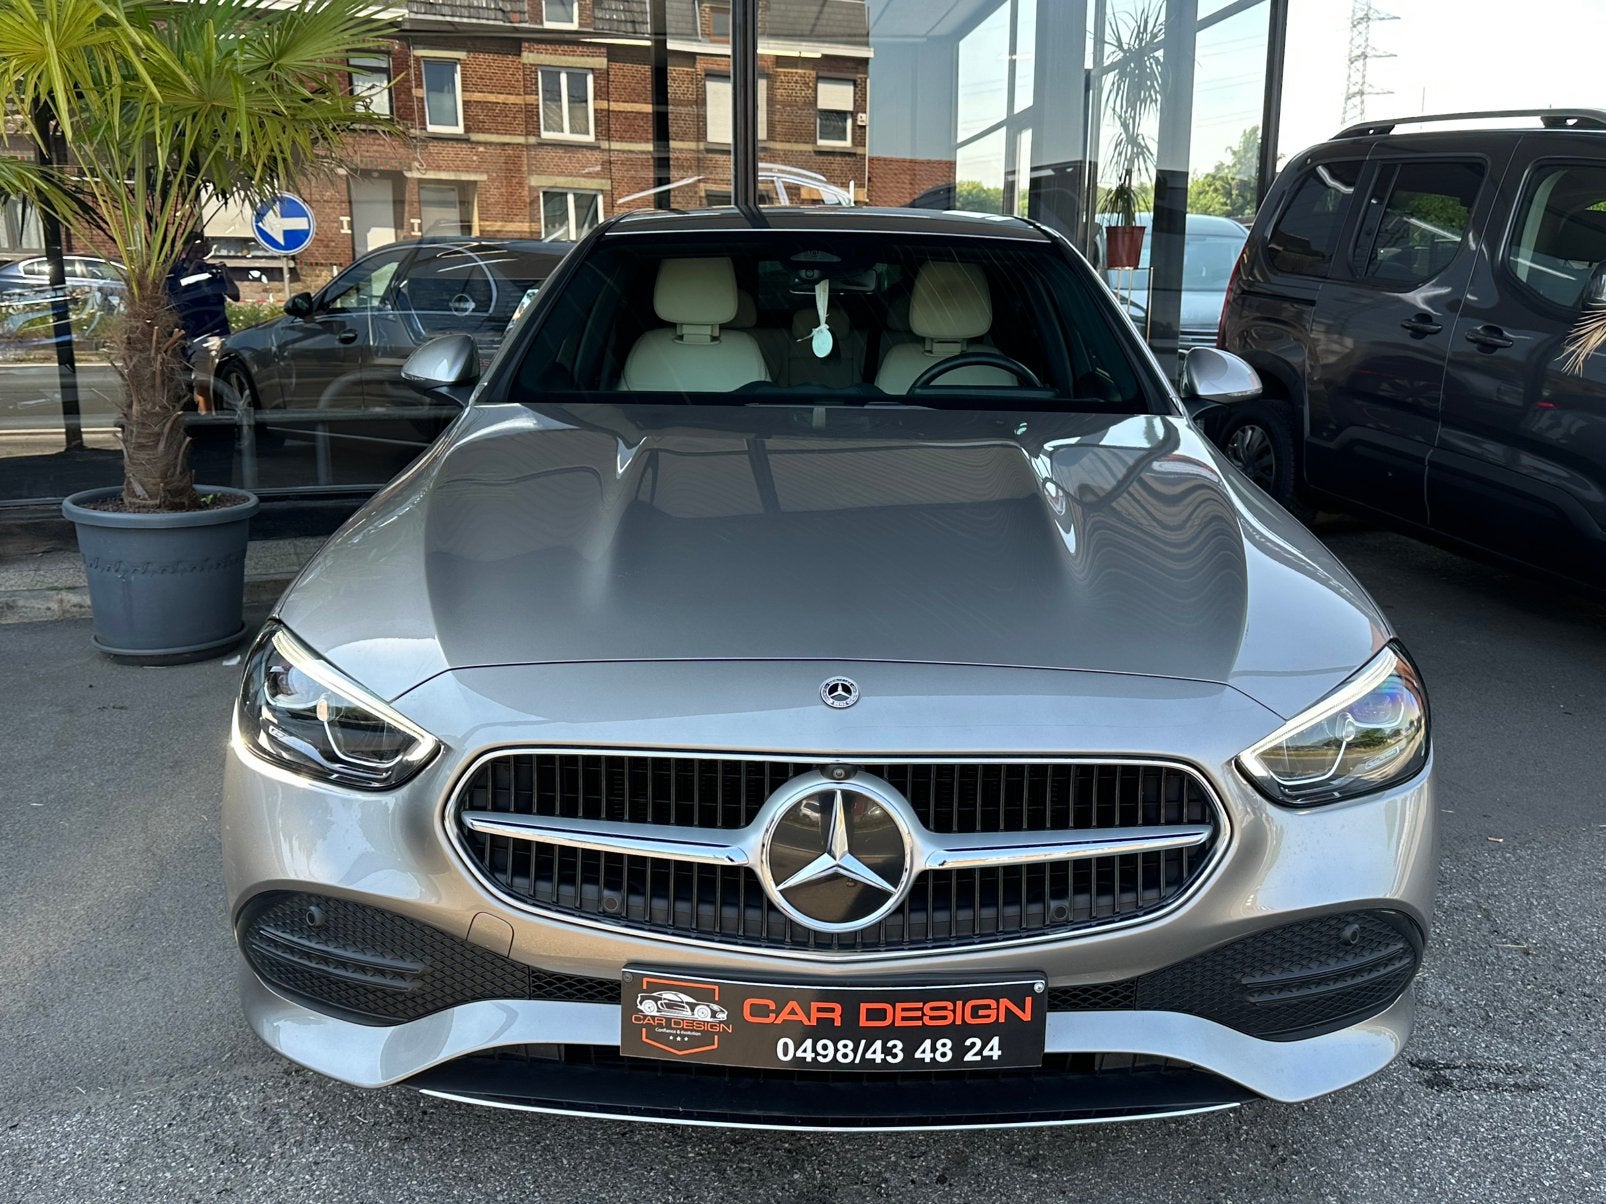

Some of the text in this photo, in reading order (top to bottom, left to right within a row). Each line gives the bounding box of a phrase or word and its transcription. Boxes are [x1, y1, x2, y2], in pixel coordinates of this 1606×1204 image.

[632, 1014, 733, 1033] CAR DESIGN
[743, 996, 1032, 1027] CAR DESIGN
[776, 1035, 1002, 1064] 0498/43 48 24
